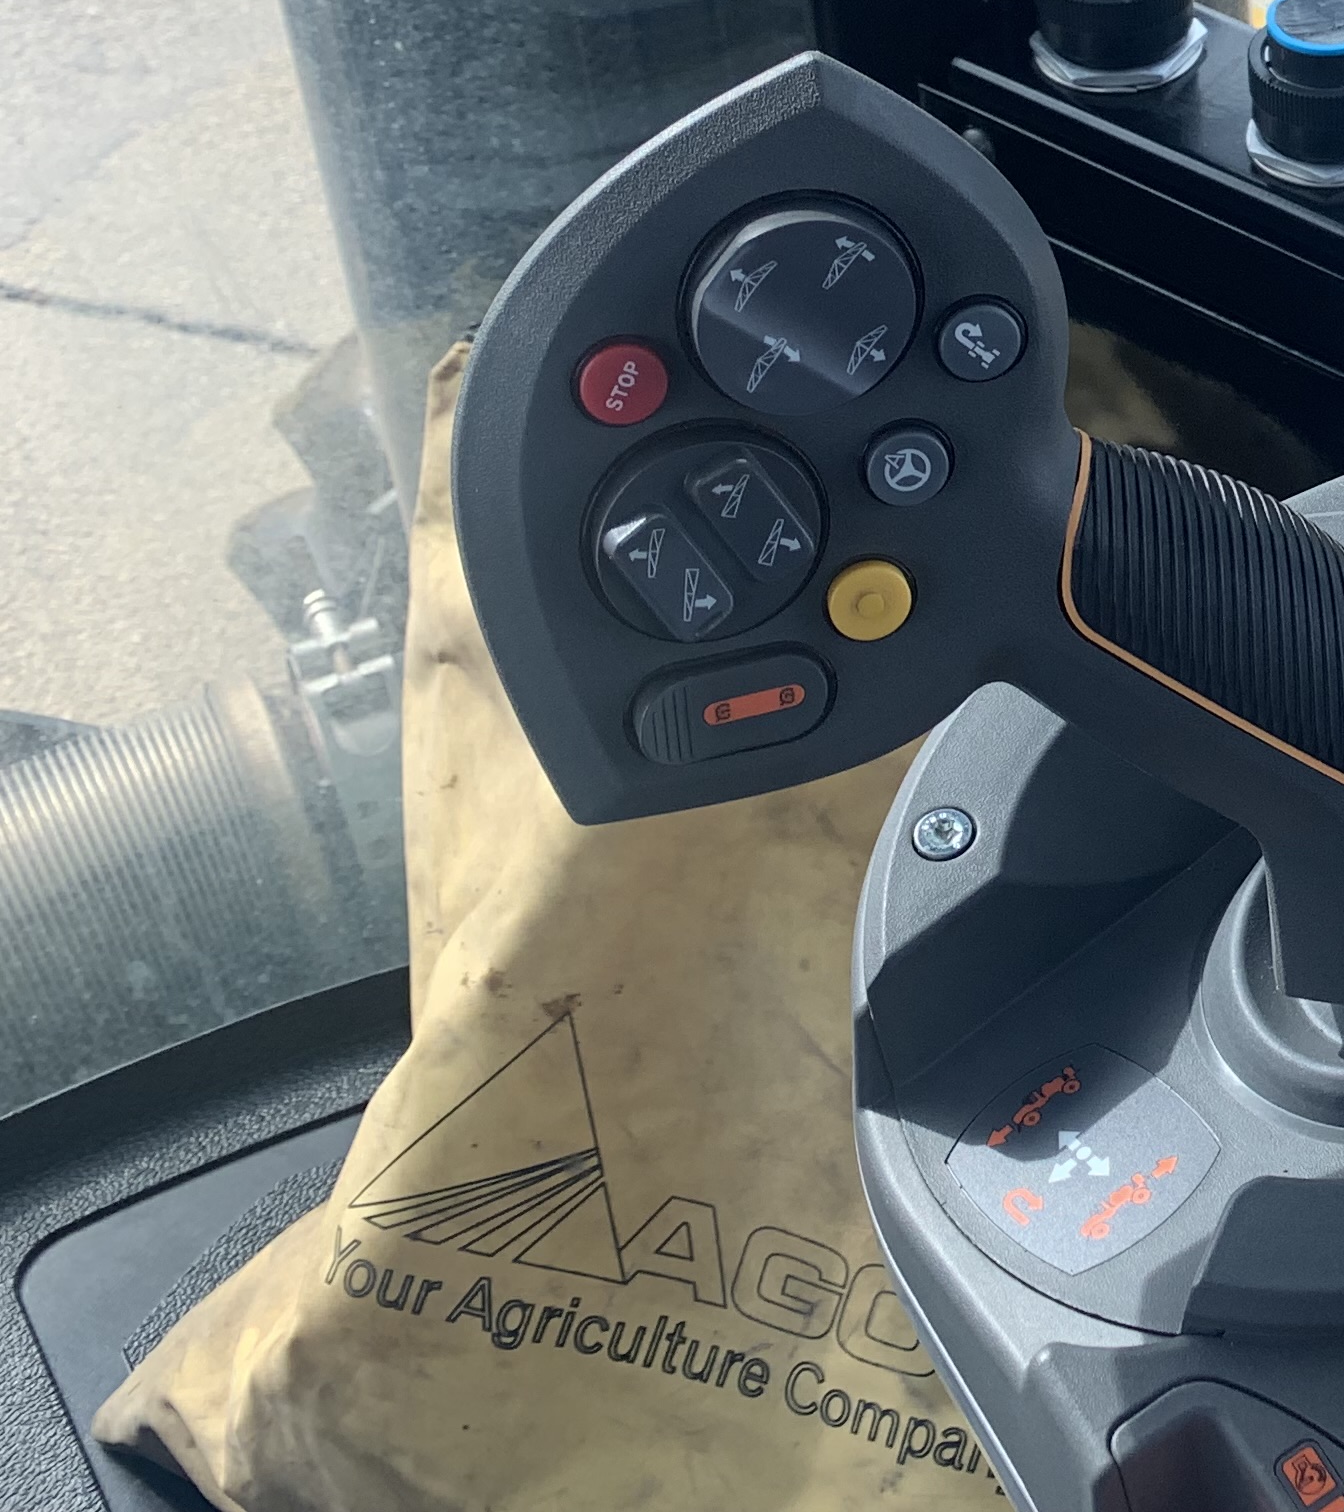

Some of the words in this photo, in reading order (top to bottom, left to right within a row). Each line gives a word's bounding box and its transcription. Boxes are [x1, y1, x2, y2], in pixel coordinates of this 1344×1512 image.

[604, 359, 640, 413] STOP
[324, 1226, 443, 1316] Your
[446, 1275, 771, 1399] Agriculture
